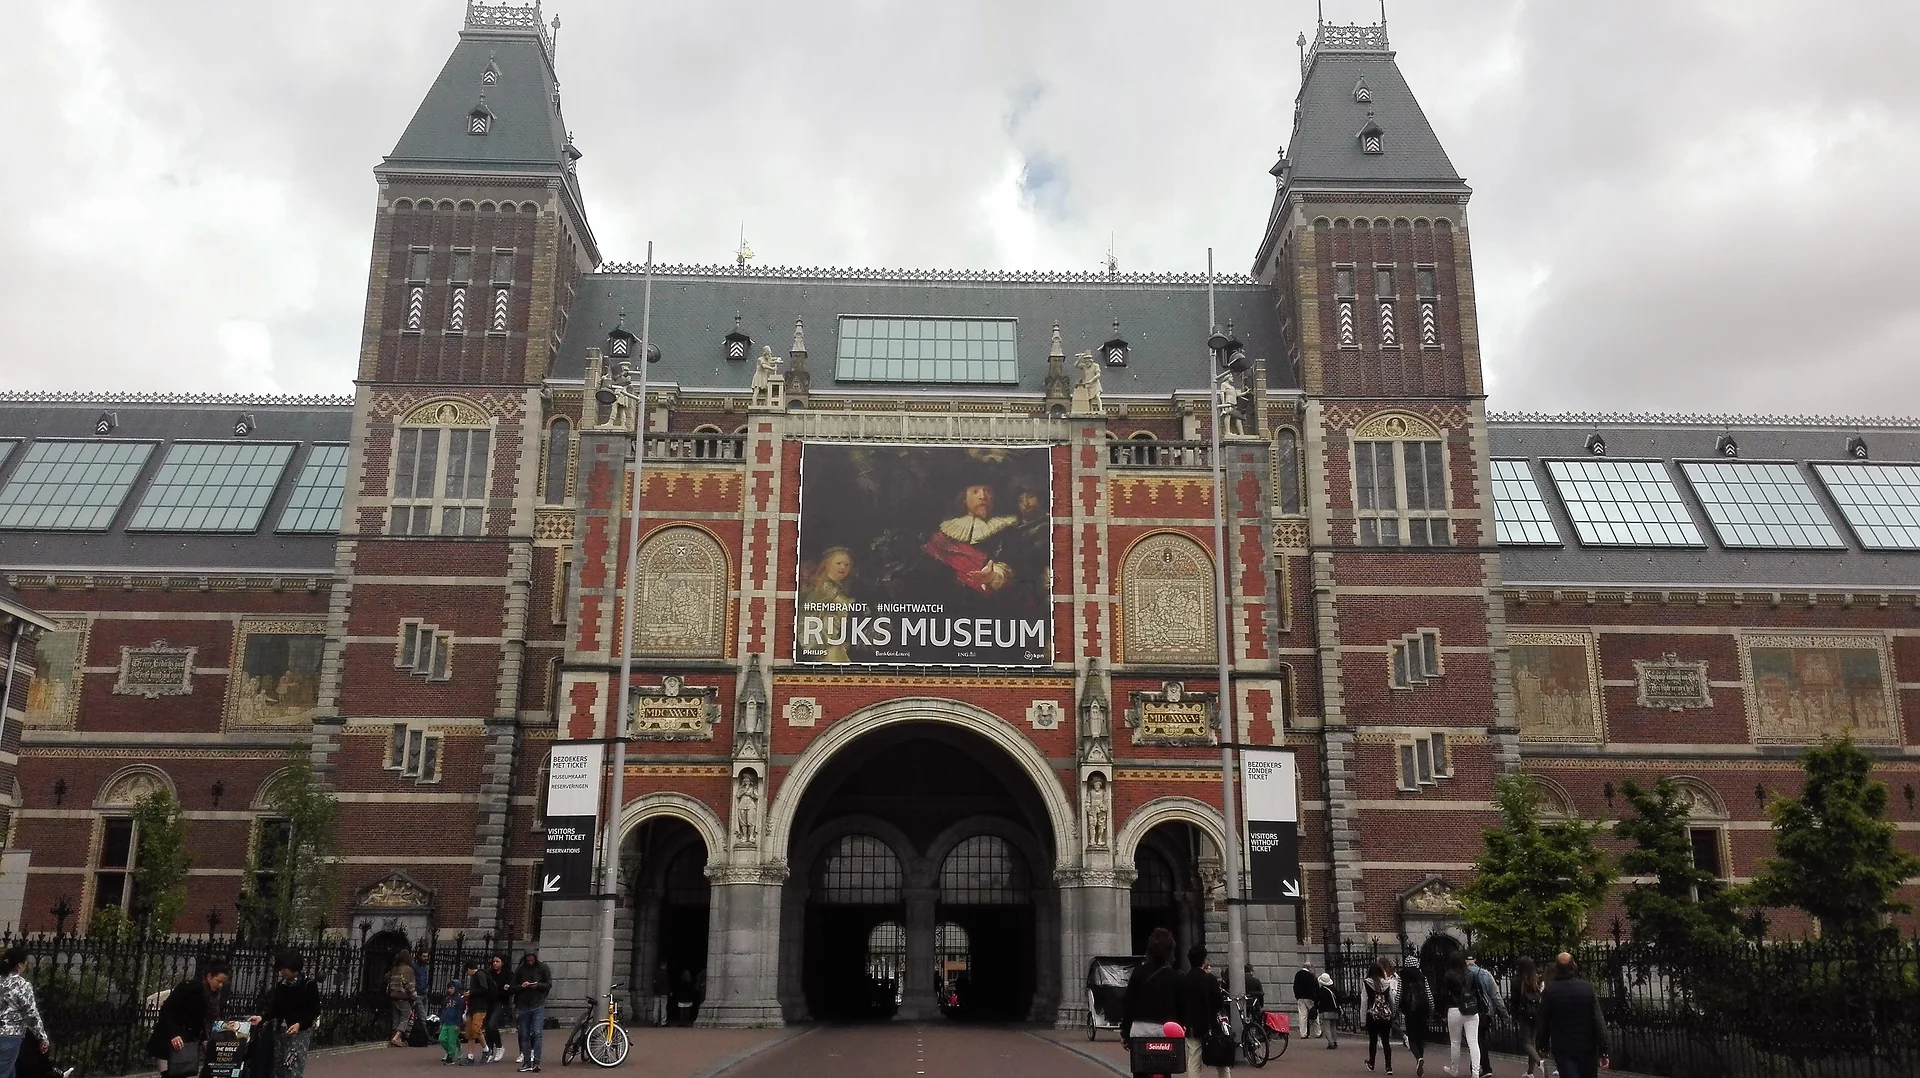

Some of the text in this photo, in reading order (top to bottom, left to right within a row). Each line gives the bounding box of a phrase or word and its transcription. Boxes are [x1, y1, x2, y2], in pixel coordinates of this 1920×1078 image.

[803, 602, 943, 613] #REMBRANDT #NIGHTWATCH
[901, 617, 1046, 648] MUSEUM
[1247, 761, 1282, 769] BEZOEKERS
[1250, 832, 1278, 840] VISITORS
[1250, 838, 1279, 846] WITHOUT
